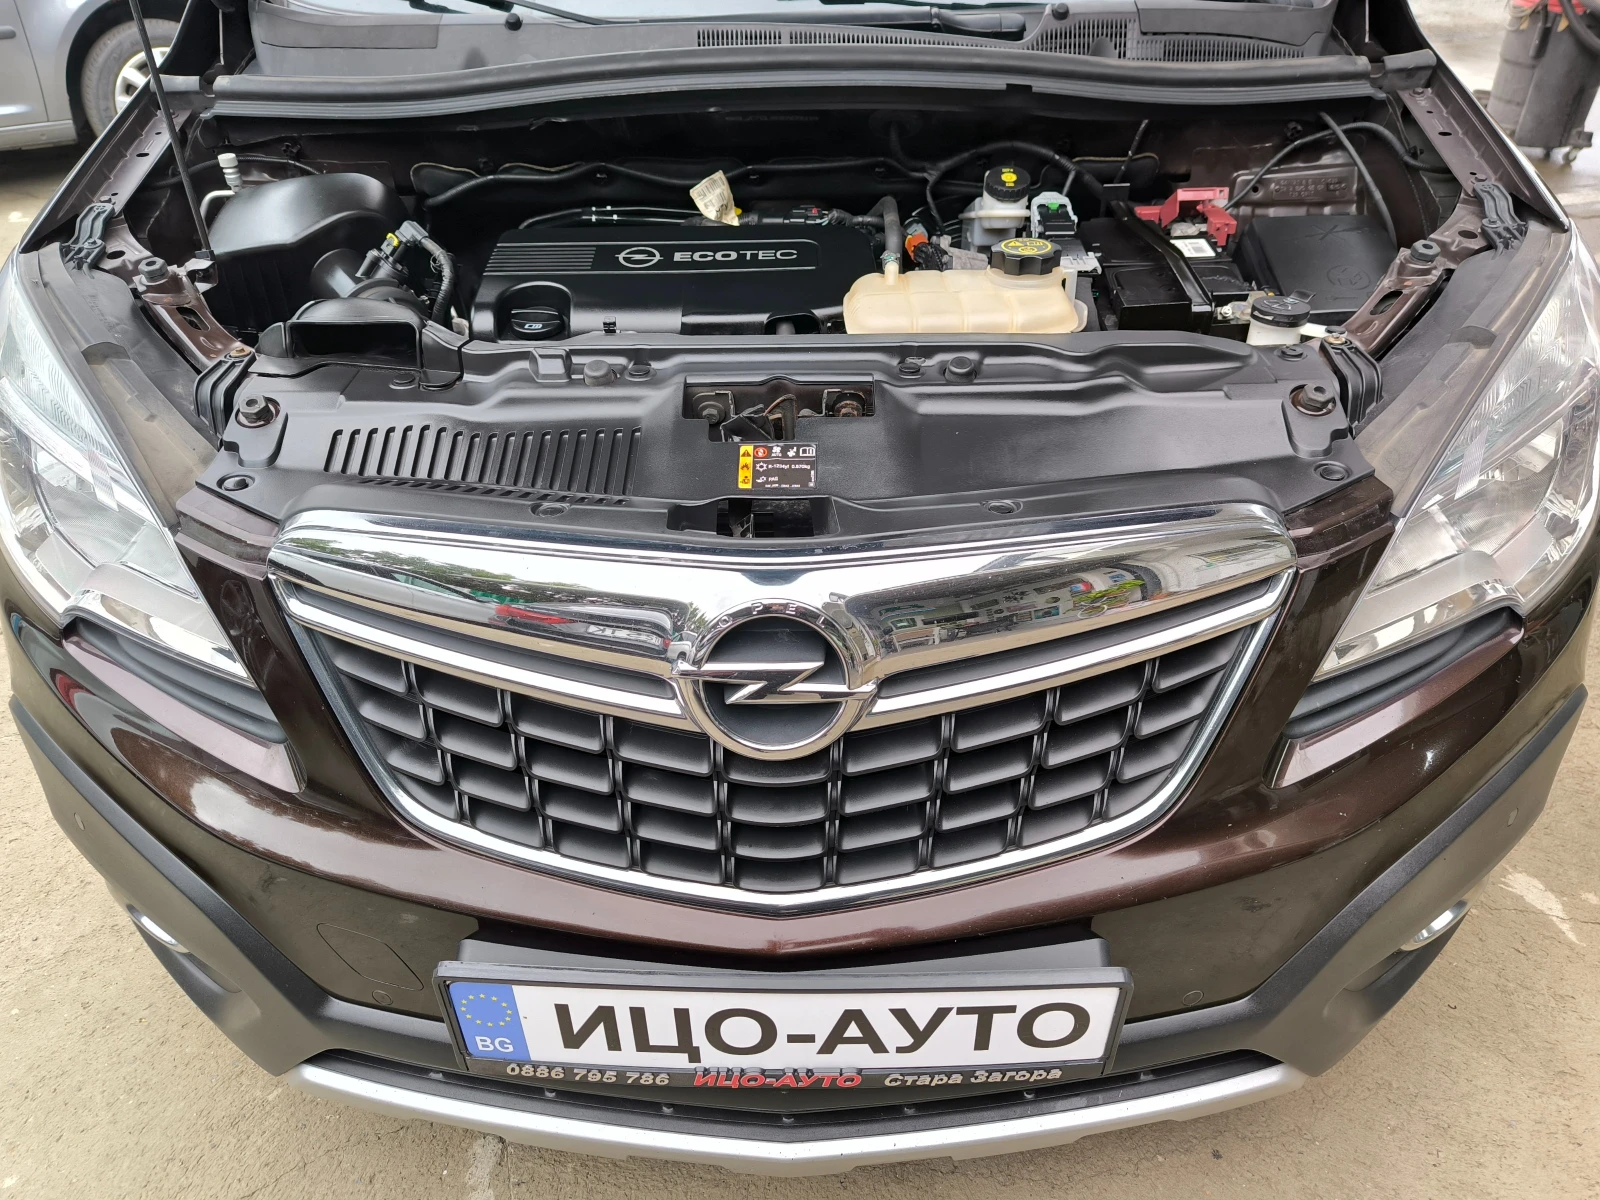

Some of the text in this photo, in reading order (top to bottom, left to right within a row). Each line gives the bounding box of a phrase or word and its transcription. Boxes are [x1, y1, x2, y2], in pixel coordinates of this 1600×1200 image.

[717, 602, 826, 629] OPEL
[474, 1035, 515, 1053] BG
[553, 1002, 1092, 1064] ИЦО-АУТО
[506, 1062, 671, 1086] 0886 795 786
[693, 1071, 863, 1089] ИЦО-АУТО
[884, 1067, 1063, 1087] Стара Загора
